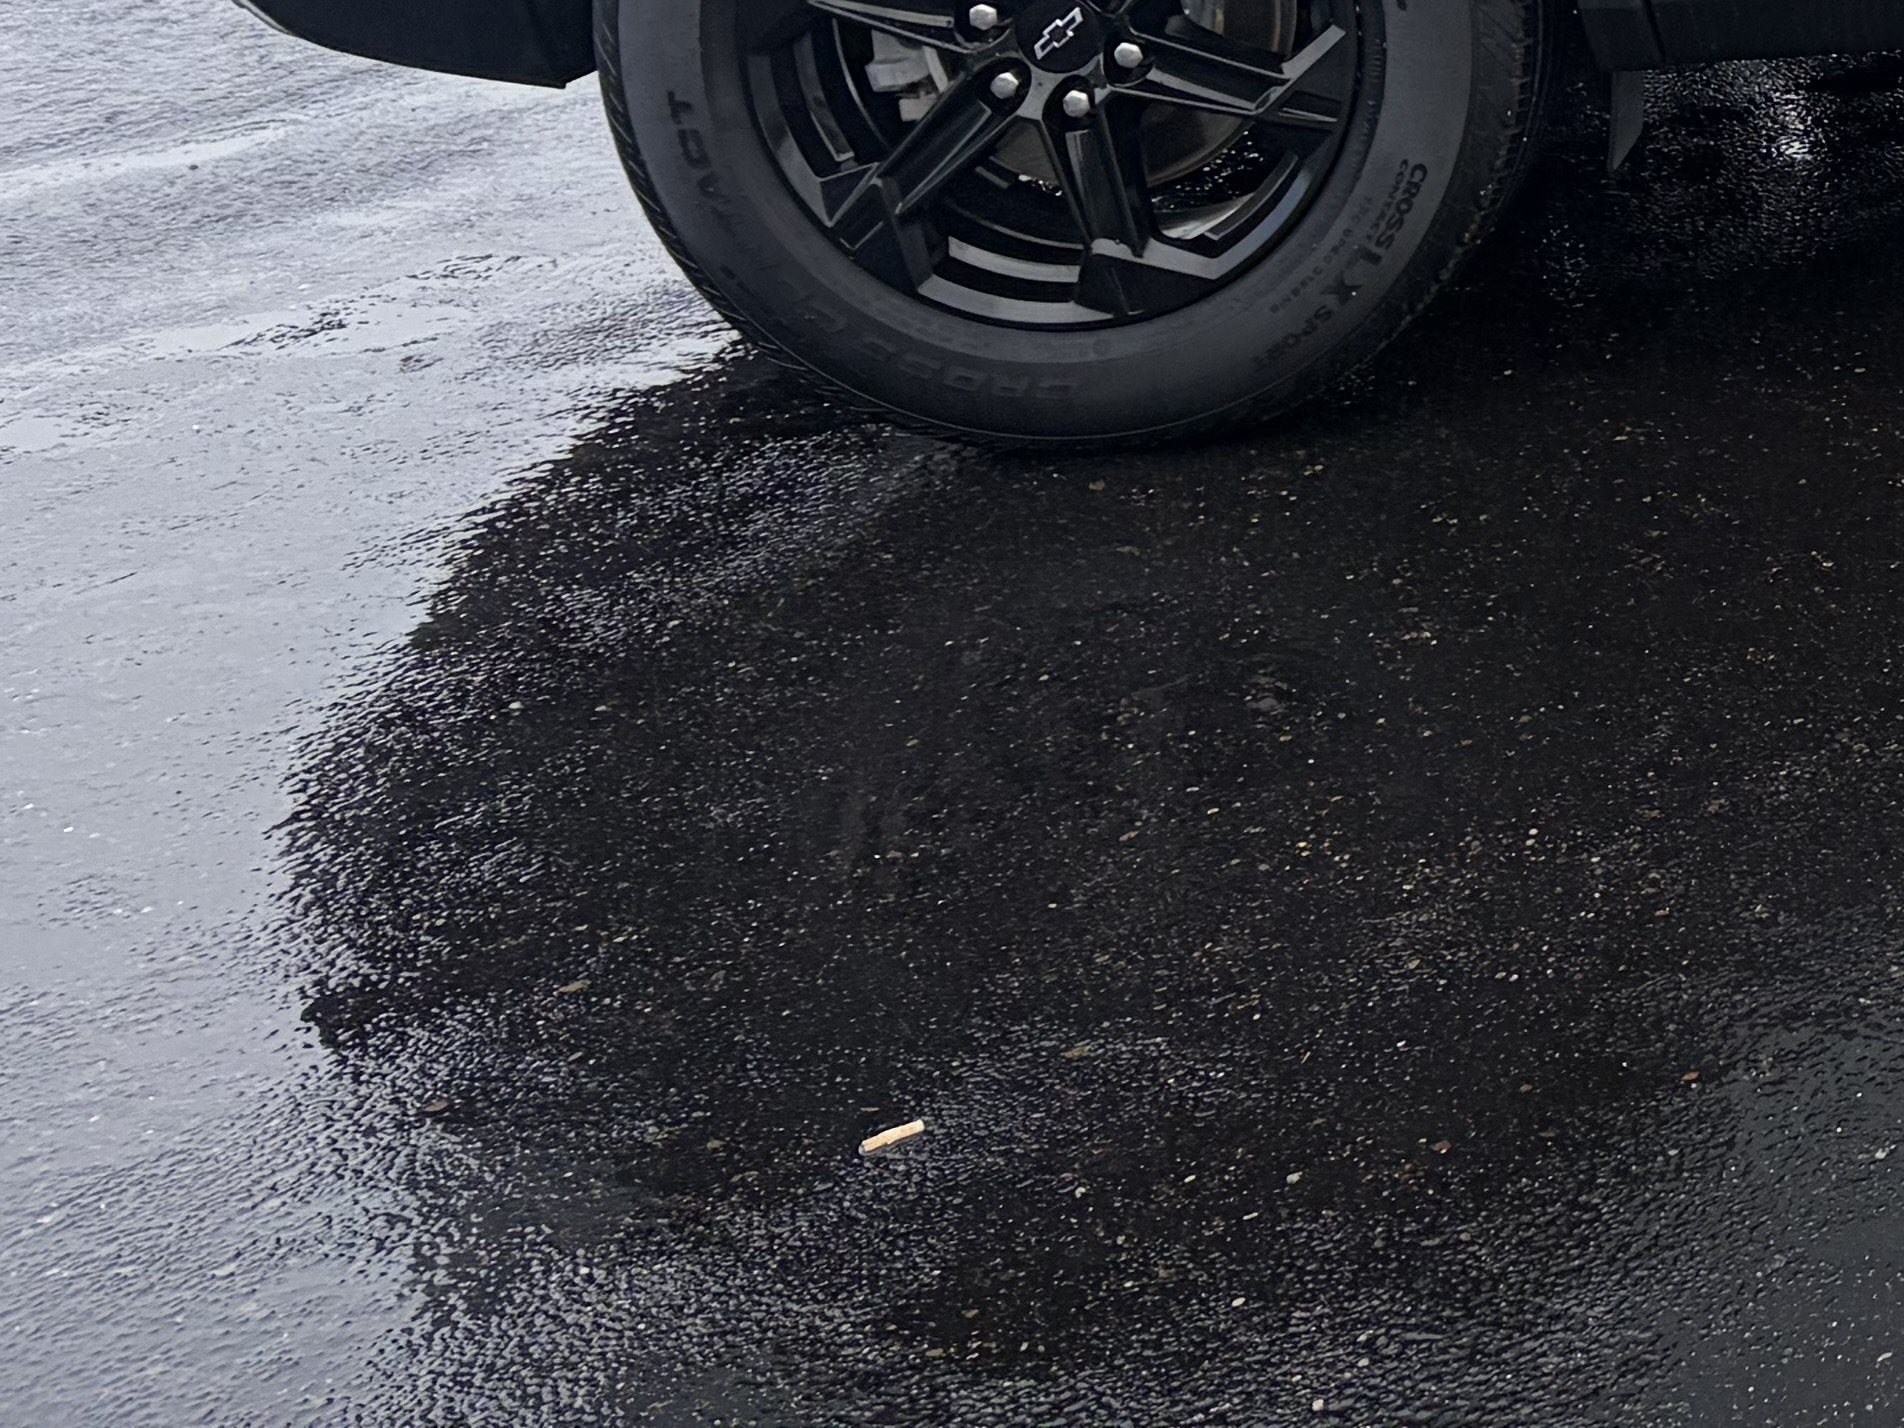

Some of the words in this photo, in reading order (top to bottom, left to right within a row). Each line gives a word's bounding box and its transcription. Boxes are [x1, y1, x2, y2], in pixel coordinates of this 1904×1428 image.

[1364, 158, 1409, 242] CONTACT
[1375, 162, 1427, 250] CROSS
[1317, 246, 1383, 308] LX
[1252, 304, 1333, 368] SPORT
